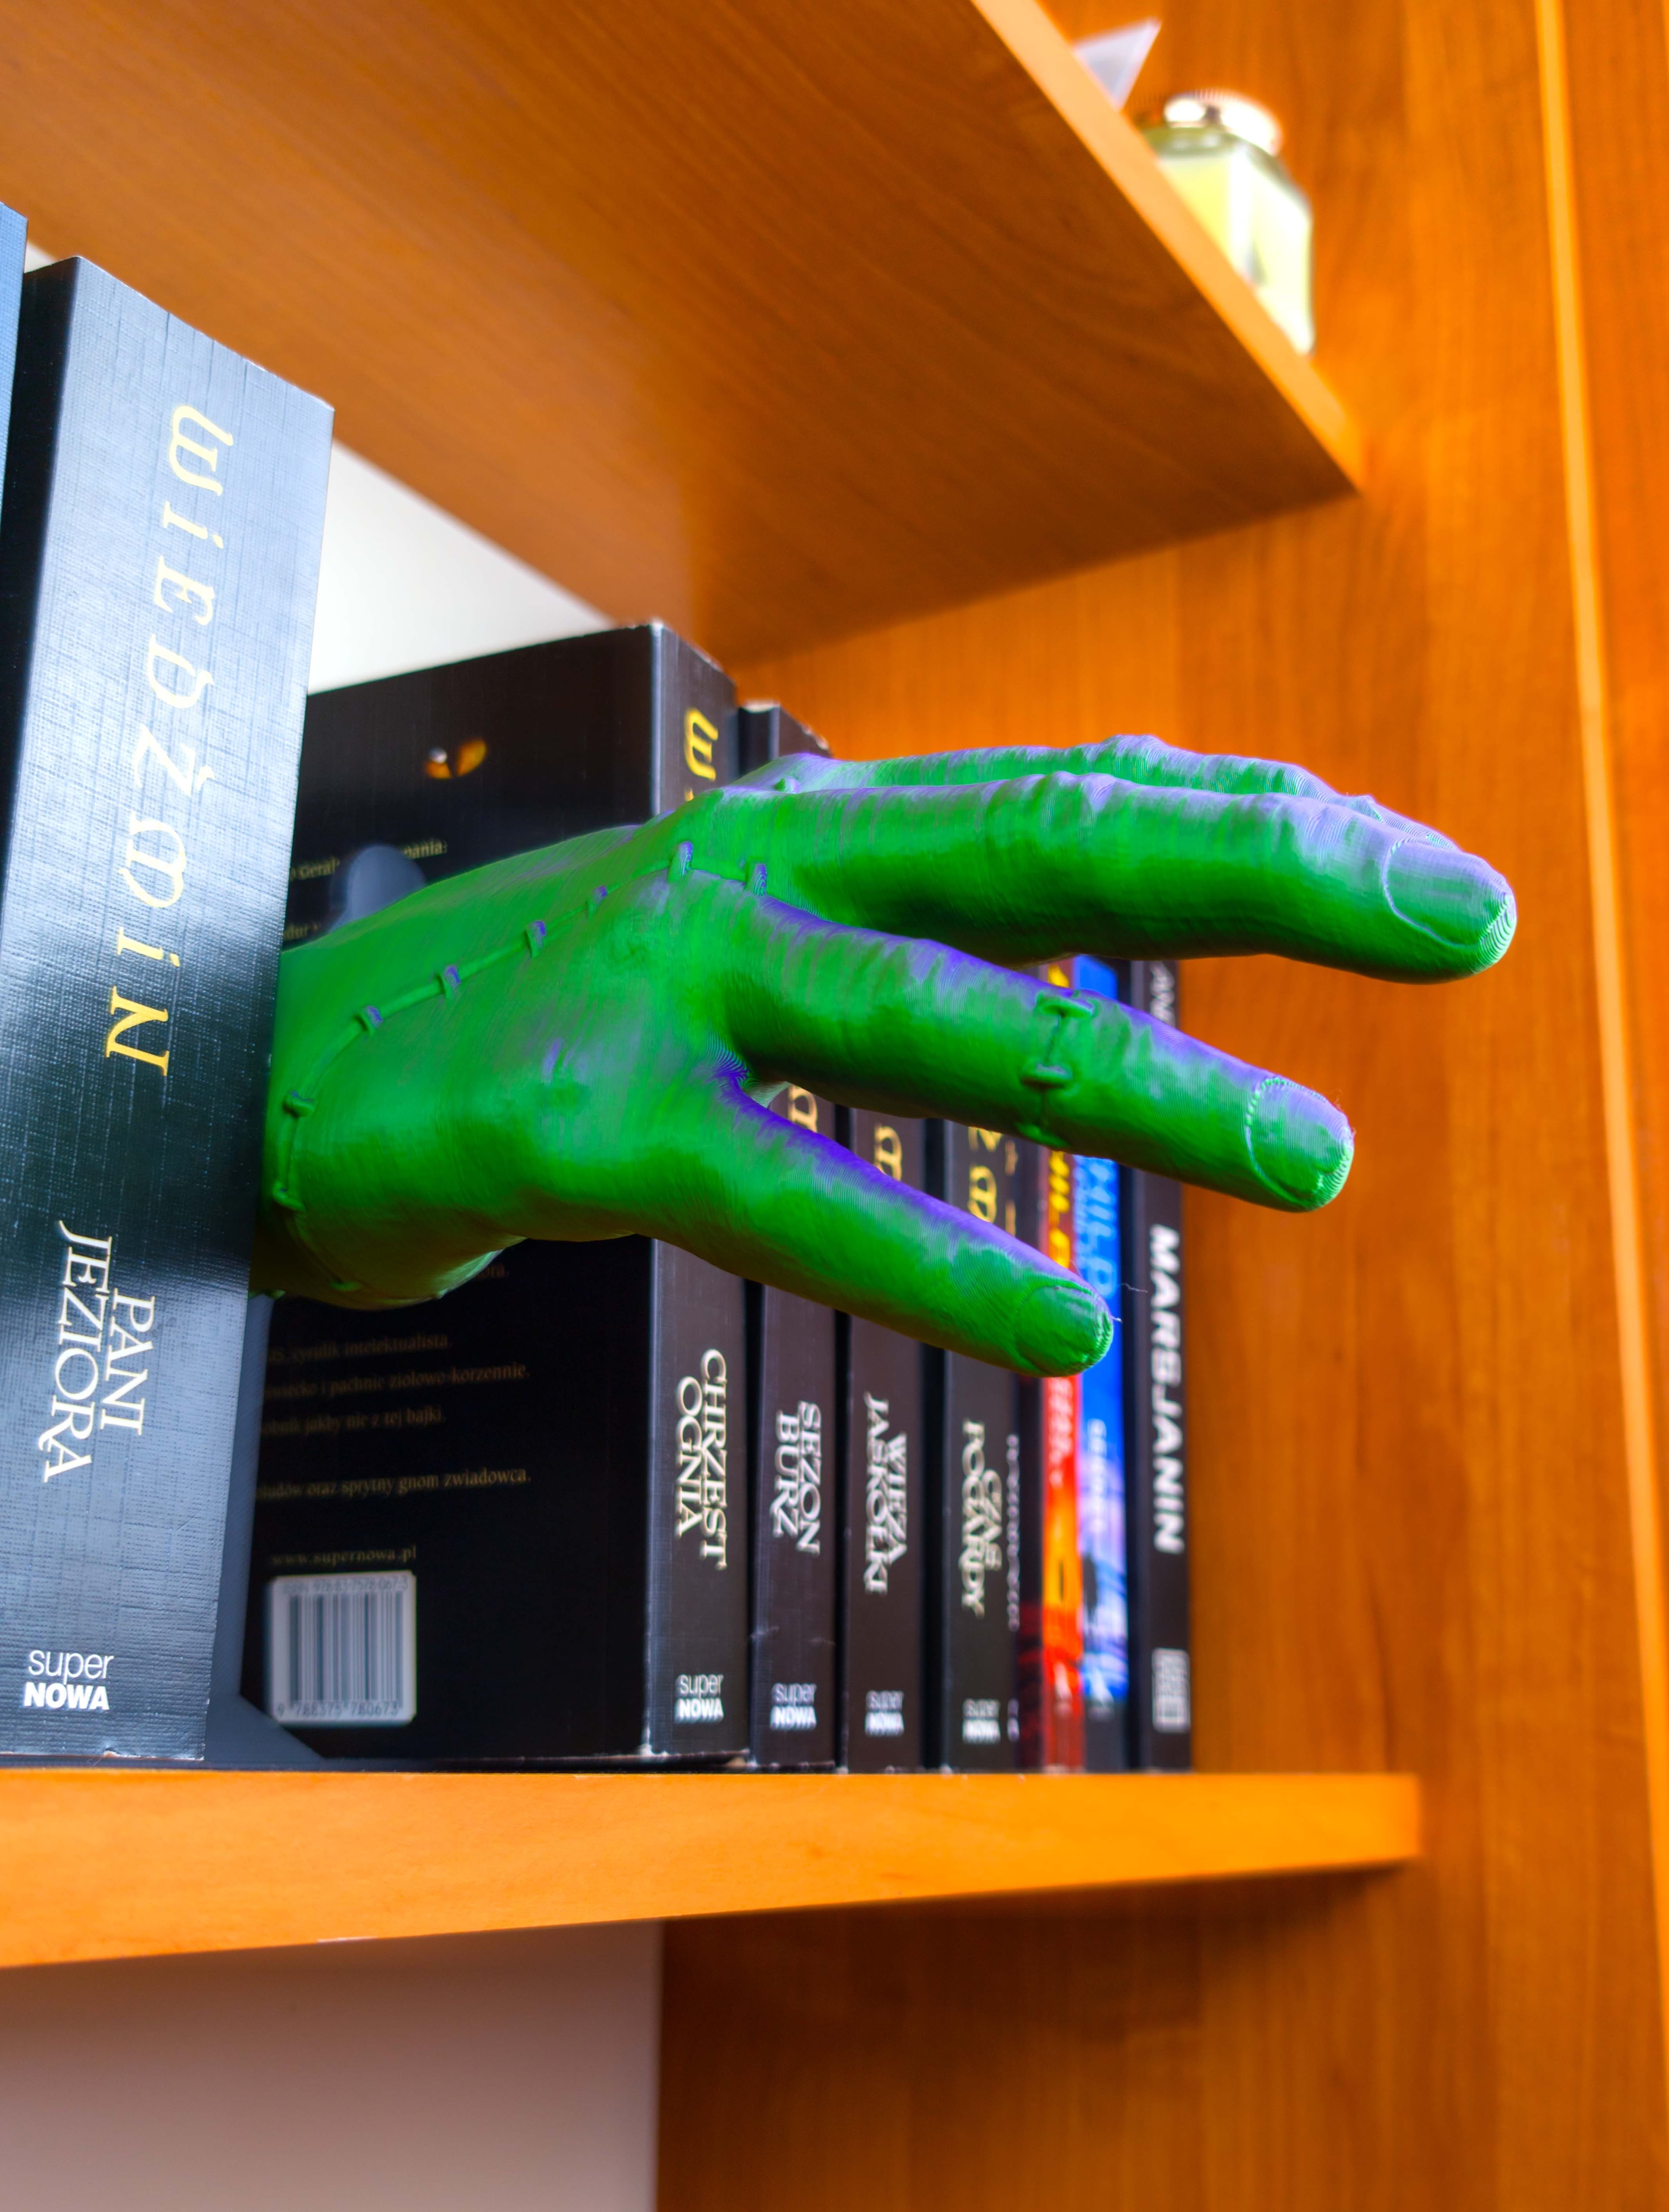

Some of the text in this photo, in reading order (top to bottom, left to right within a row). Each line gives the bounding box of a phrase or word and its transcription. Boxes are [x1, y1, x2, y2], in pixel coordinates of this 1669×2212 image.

[39, 1219, 113, 1483] JEZIORA
[100, 1287, 155, 1435] PANI
[1150, 1223, 1185, 1555] MARSJANIN
[397, 1473, 439, 1496] gnom
[675, 1376, 702, 1539] OGNIA
[700, 1349, 727, 1570] CHRZEST
[770, 1409, 800, 1538] BURZ
[796, 1399, 822, 1557] SEZON
[23, 1682, 110, 1710] NOWA
[28, 1650, 115, 1686] super
[675, 1674, 724, 1699] super
[771, 1683, 817, 1707] super
[674, 1698, 724, 1723] NOWA
[770, 1706, 817, 1731] NOWA
